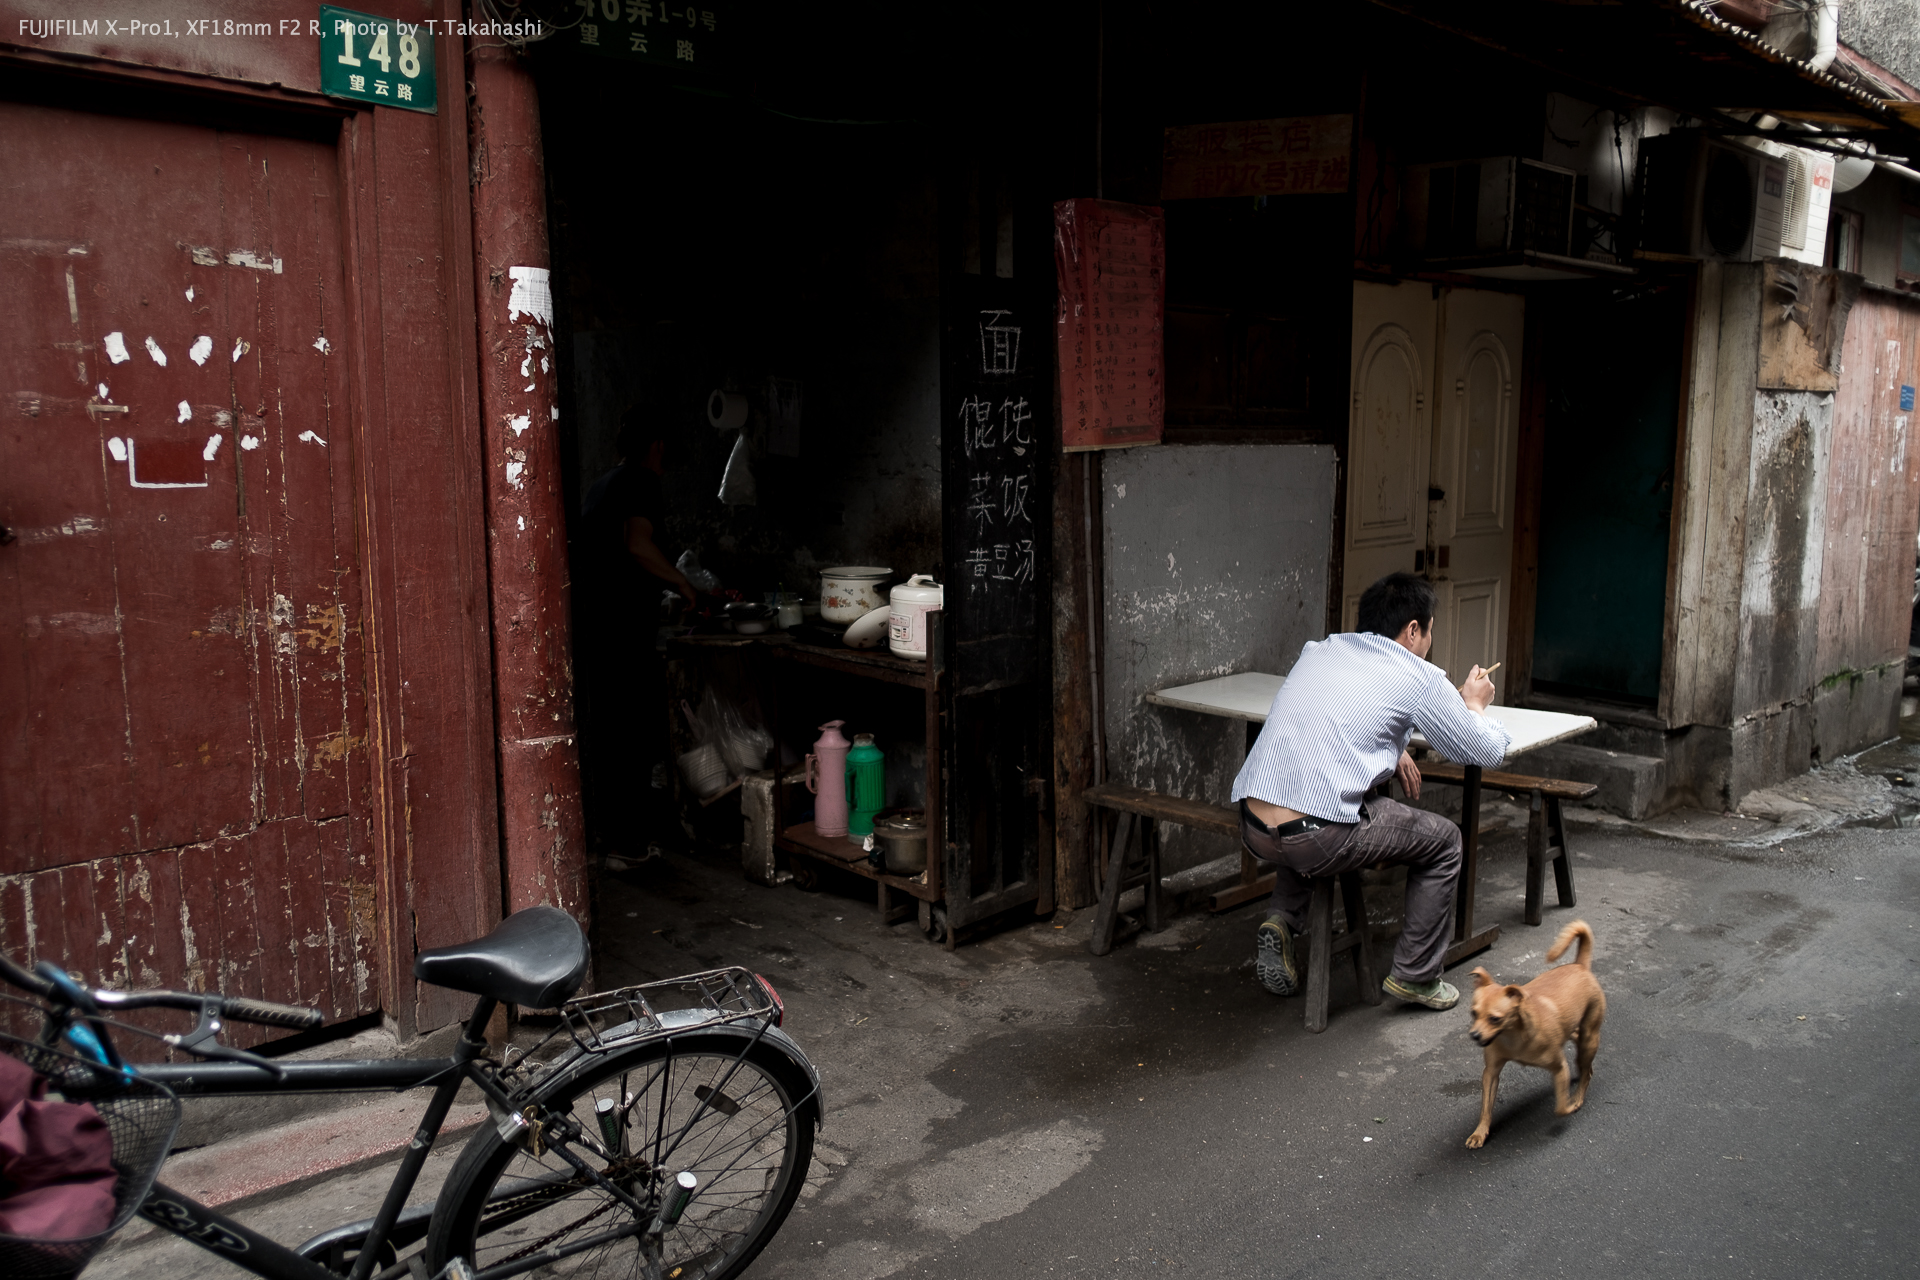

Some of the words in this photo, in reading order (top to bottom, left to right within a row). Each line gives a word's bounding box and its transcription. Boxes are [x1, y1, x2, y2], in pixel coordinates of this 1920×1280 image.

[338, 22, 421, 79] 148
[579, 22, 695, 63] 望云路
[349, 74, 413, 102] 望云路
[1195, 121, 1311, 159] 服装店
[1193, 156, 1348, 197] 弄内九号请进
[980, 309, 1022, 374] 面
[959, 395, 1032, 459] 馄饨
[967, 472, 1032, 536] 菜饭
[965, 540, 1035, 593] 黄豆汤
[140, 1192, 250, 1253] &P
